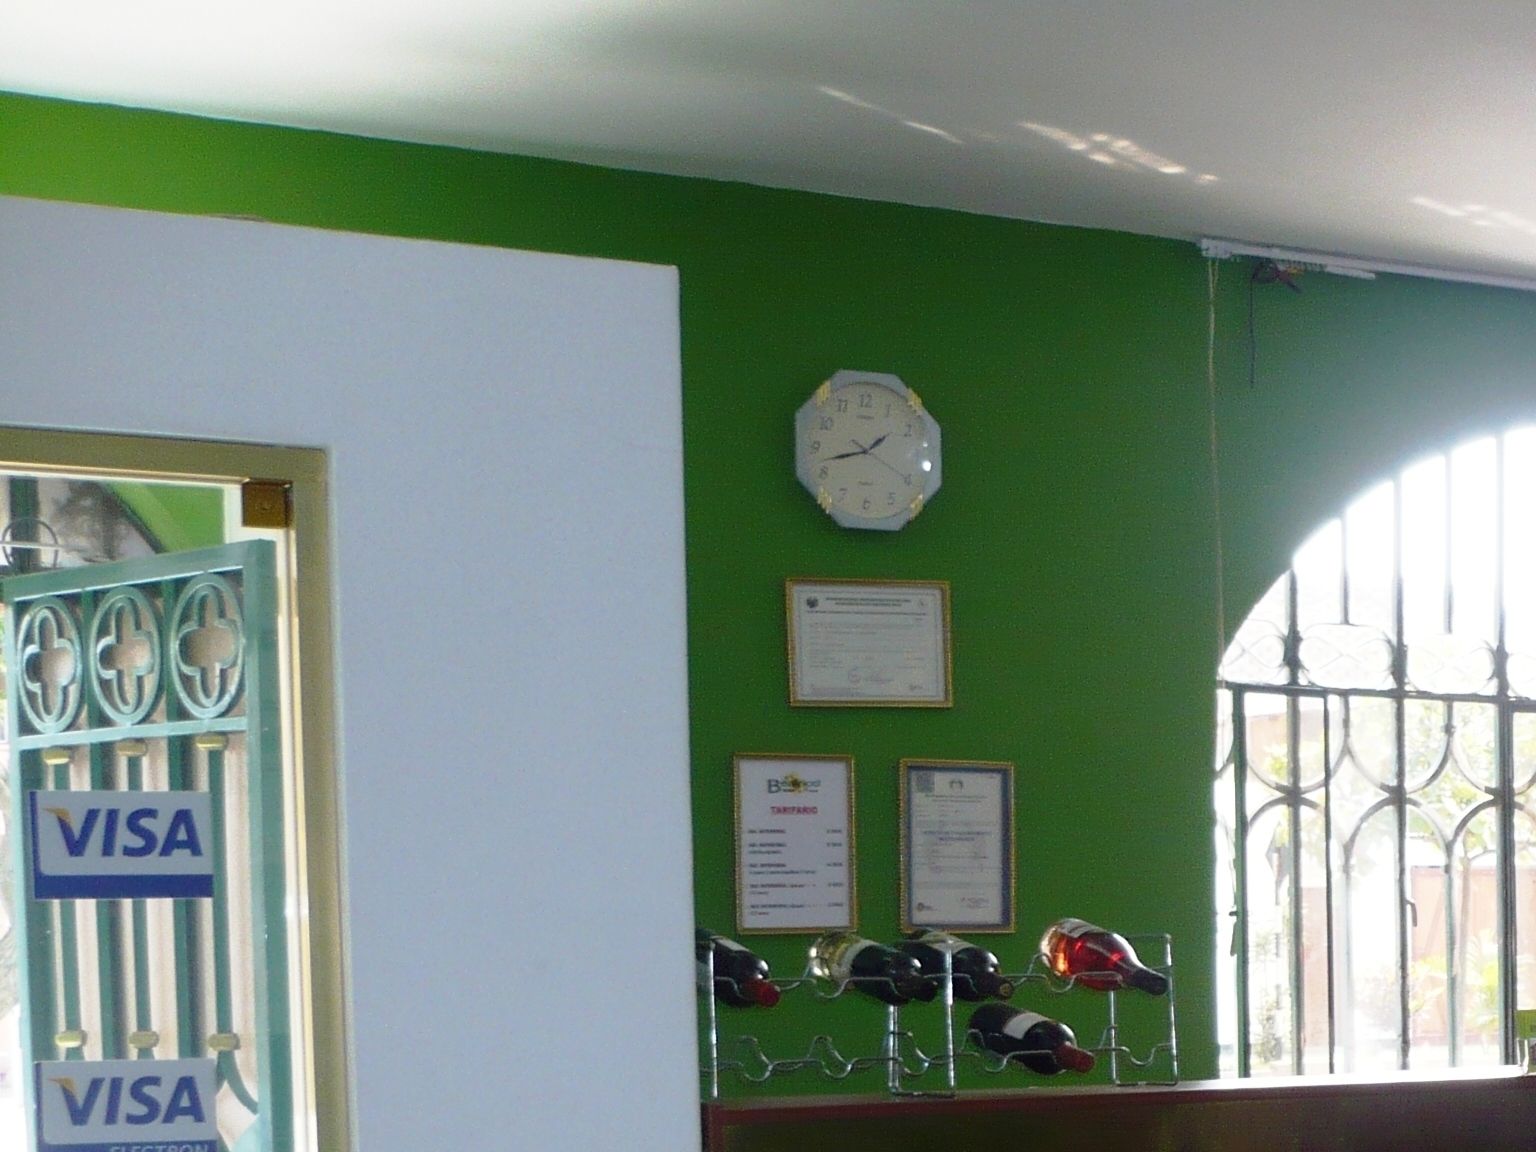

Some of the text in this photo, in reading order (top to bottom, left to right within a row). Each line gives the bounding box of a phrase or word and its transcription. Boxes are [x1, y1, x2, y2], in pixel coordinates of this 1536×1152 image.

[837, 398, 848, 413] 11
[859, 393, 874, 409] 12
[885, 404, 892, 417] 1
[819, 416, 834, 431] 10
[904, 424, 913, 438] 2
[811, 440, 821, 455] 9
[838, 488, 847, 502] 7
[888, 492, 896, 506] 5
[862, 497, 870, 510] 6
[40, 807, 204, 858] VISA
[47, 1075, 206, 1126] VISA
